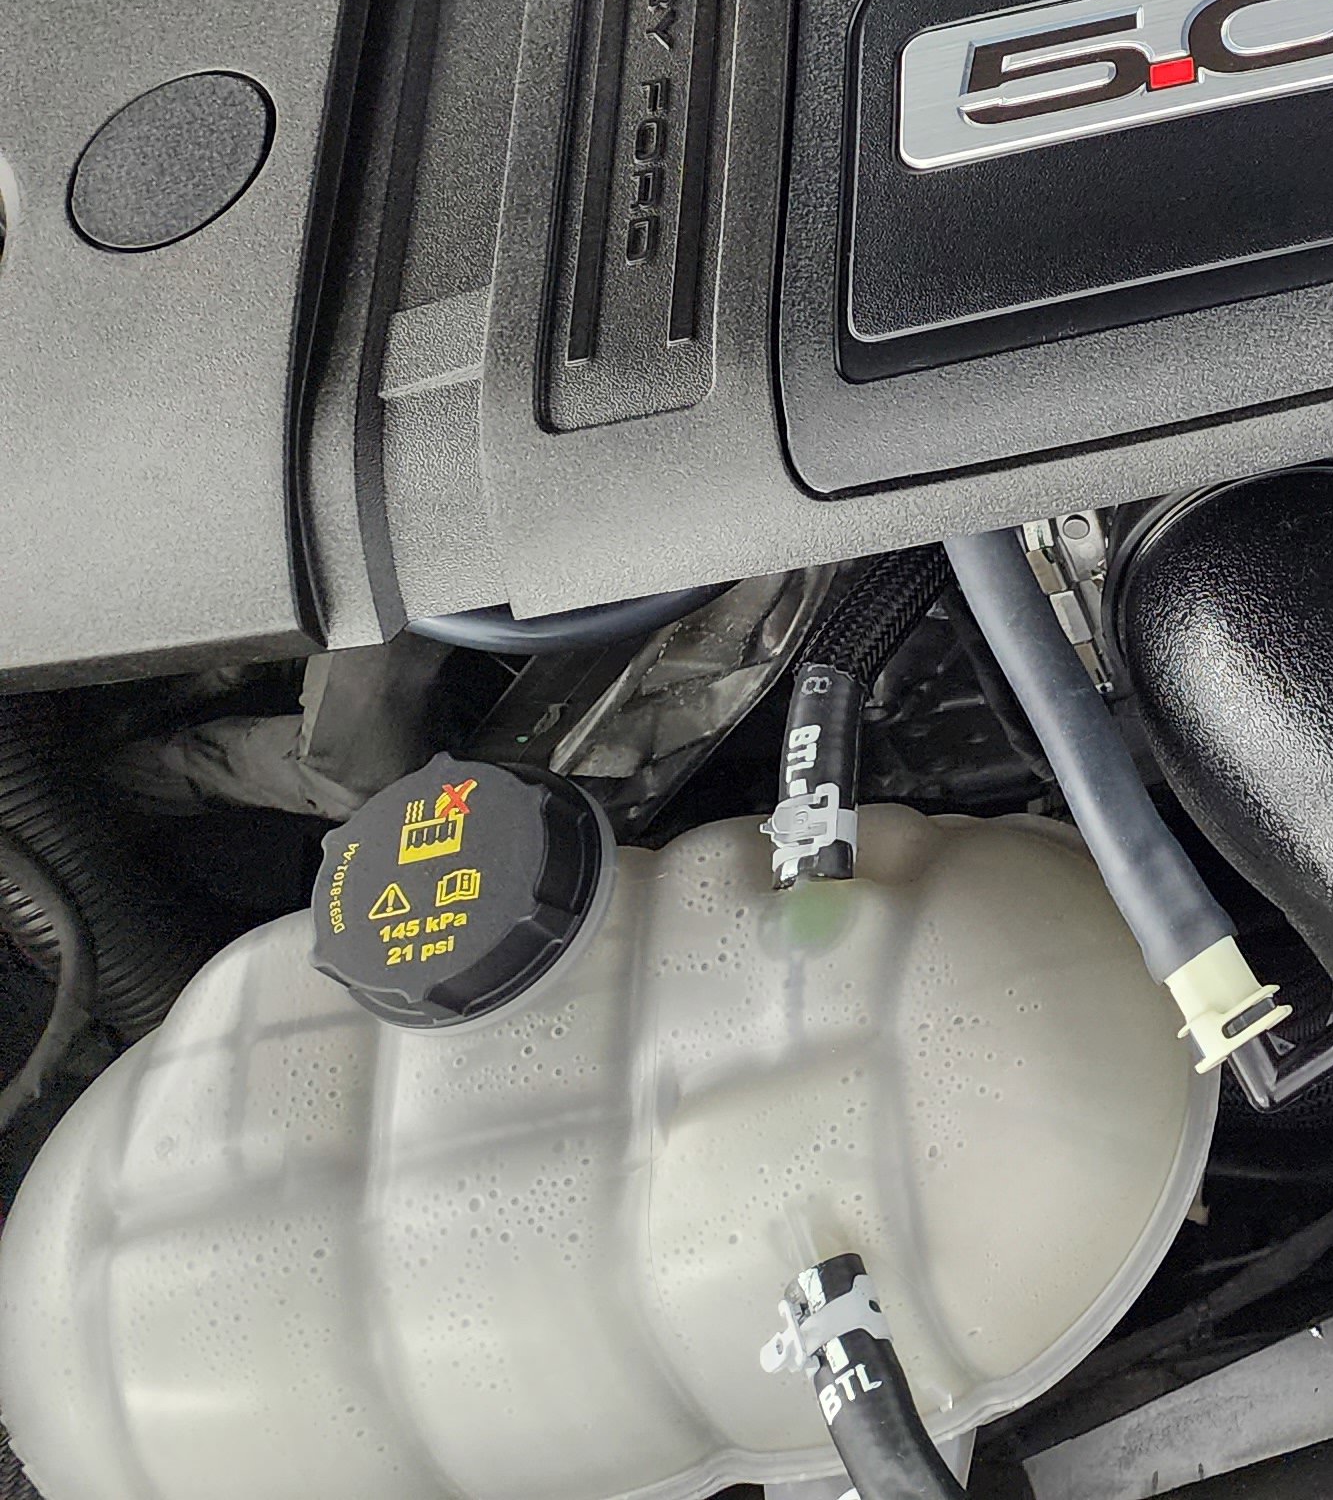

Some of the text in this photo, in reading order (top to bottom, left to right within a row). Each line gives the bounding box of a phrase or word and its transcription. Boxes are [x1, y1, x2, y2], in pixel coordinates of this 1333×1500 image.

[625, 77, 670, 266] FORD
[785, 723, 822, 784] BTL
[329, 841, 360, 935] DG93-8101-AA
[379, 911, 468, 943] 145 kPa
[386, 935, 455, 966] 21 psi
[818, 1362, 883, 1426] BTL
